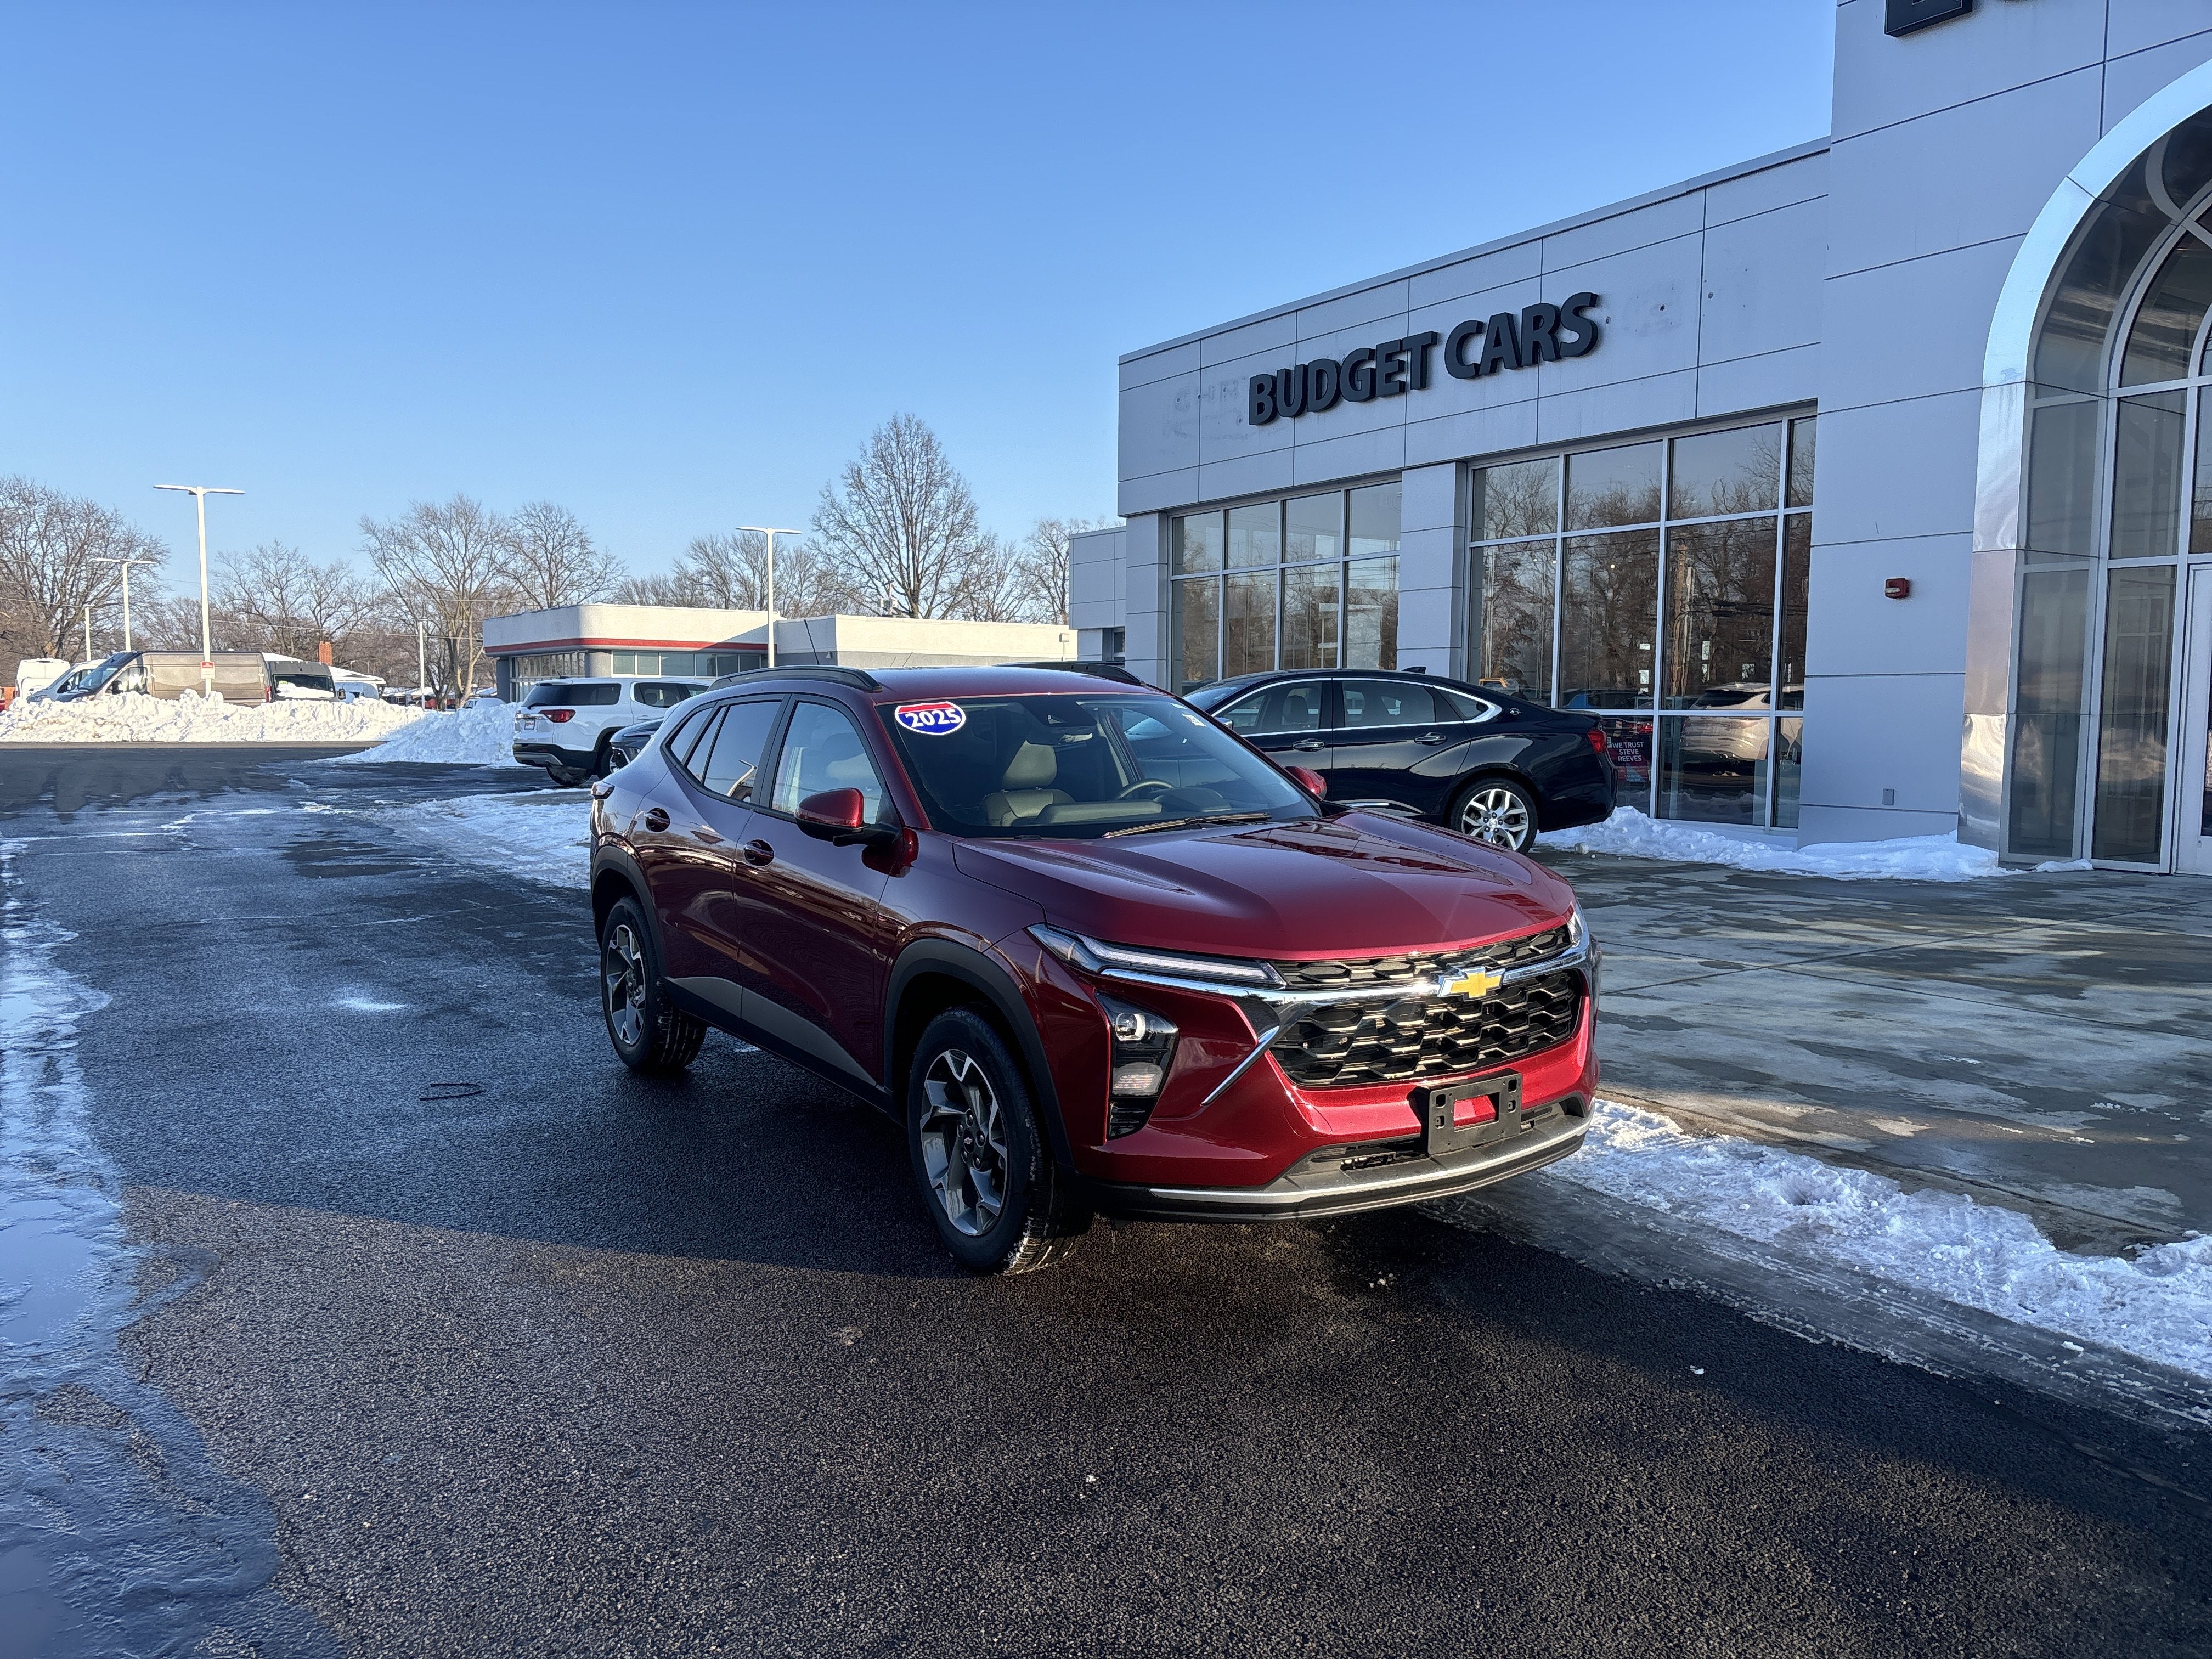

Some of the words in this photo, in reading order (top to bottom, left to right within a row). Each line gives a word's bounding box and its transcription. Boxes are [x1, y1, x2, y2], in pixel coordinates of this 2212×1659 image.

[1249, 331, 1438, 426] BUDGET
[1444, 291, 1599, 379] CARS
[905, 709, 961, 727] 2025
